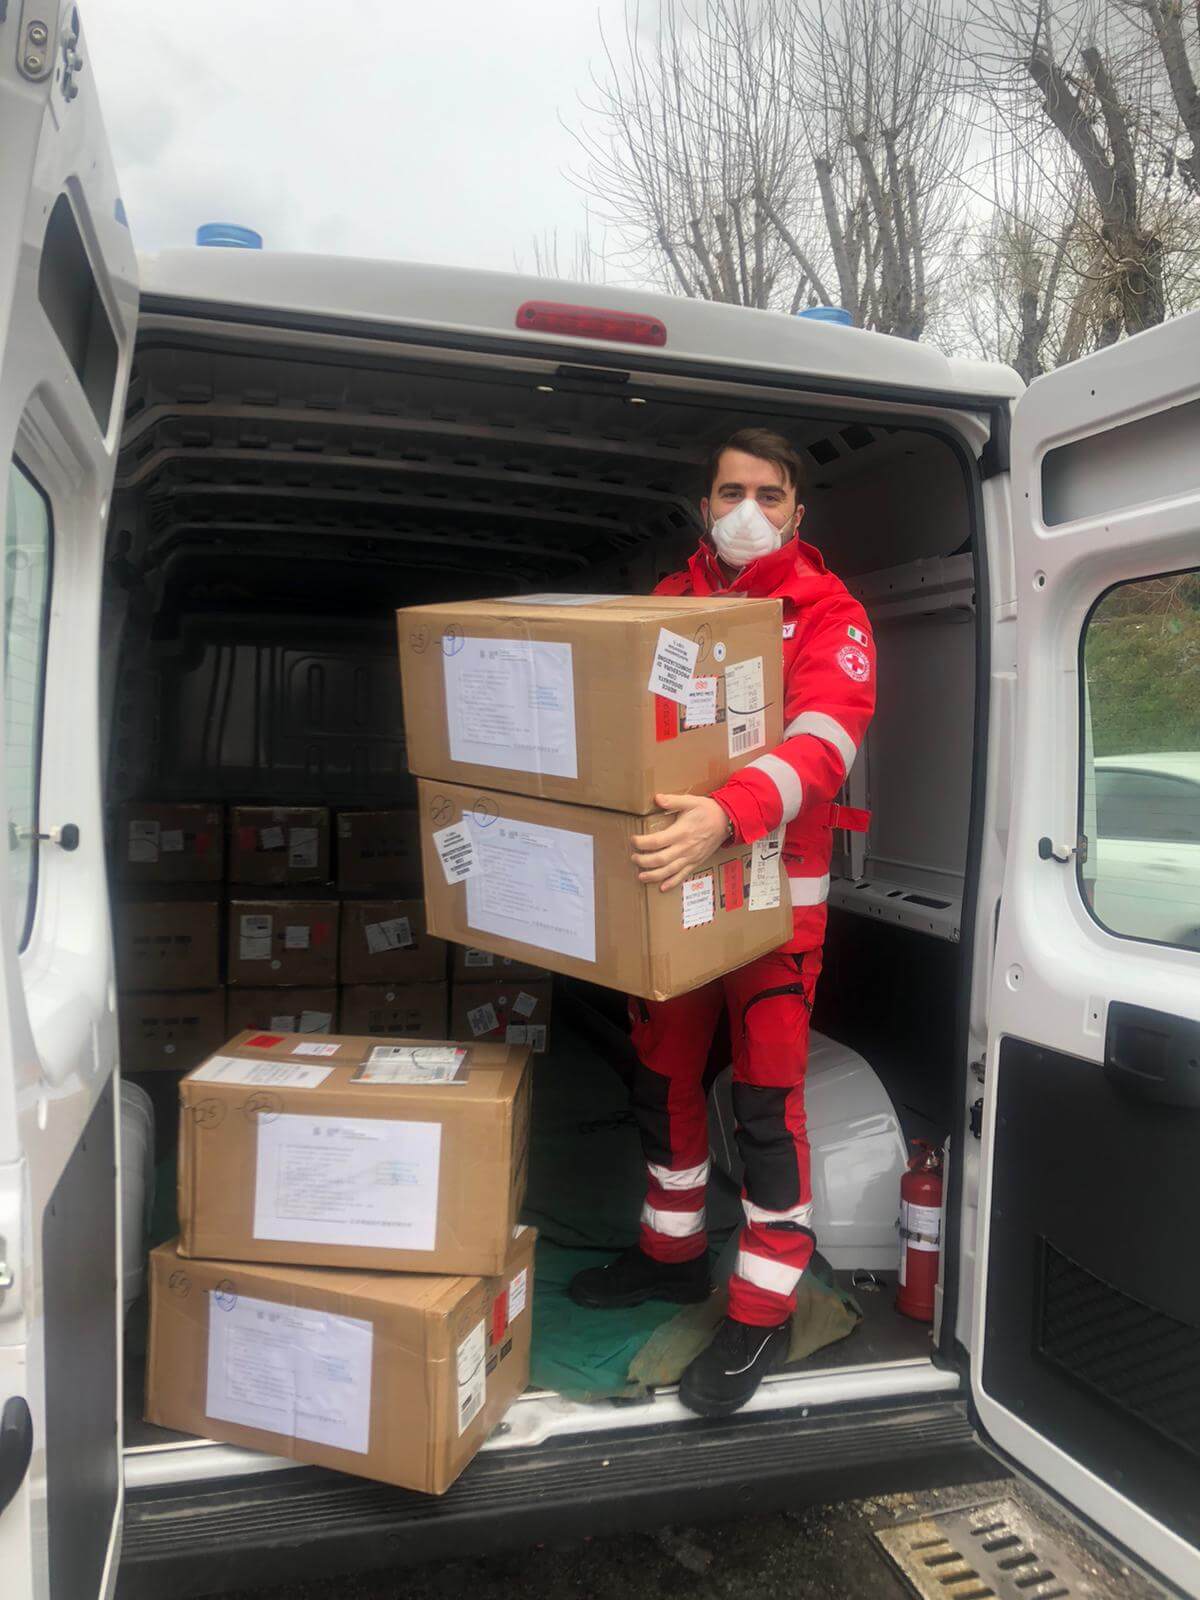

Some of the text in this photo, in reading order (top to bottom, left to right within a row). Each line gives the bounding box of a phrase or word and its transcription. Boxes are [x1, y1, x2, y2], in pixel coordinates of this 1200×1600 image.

[657, 654, 692, 674] DOMICILIAZIONE
[663, 664, 690, 680] PROCEDURA
[667, 672, 678, 681] CON
[662, 683, 677, 694] MERCE
